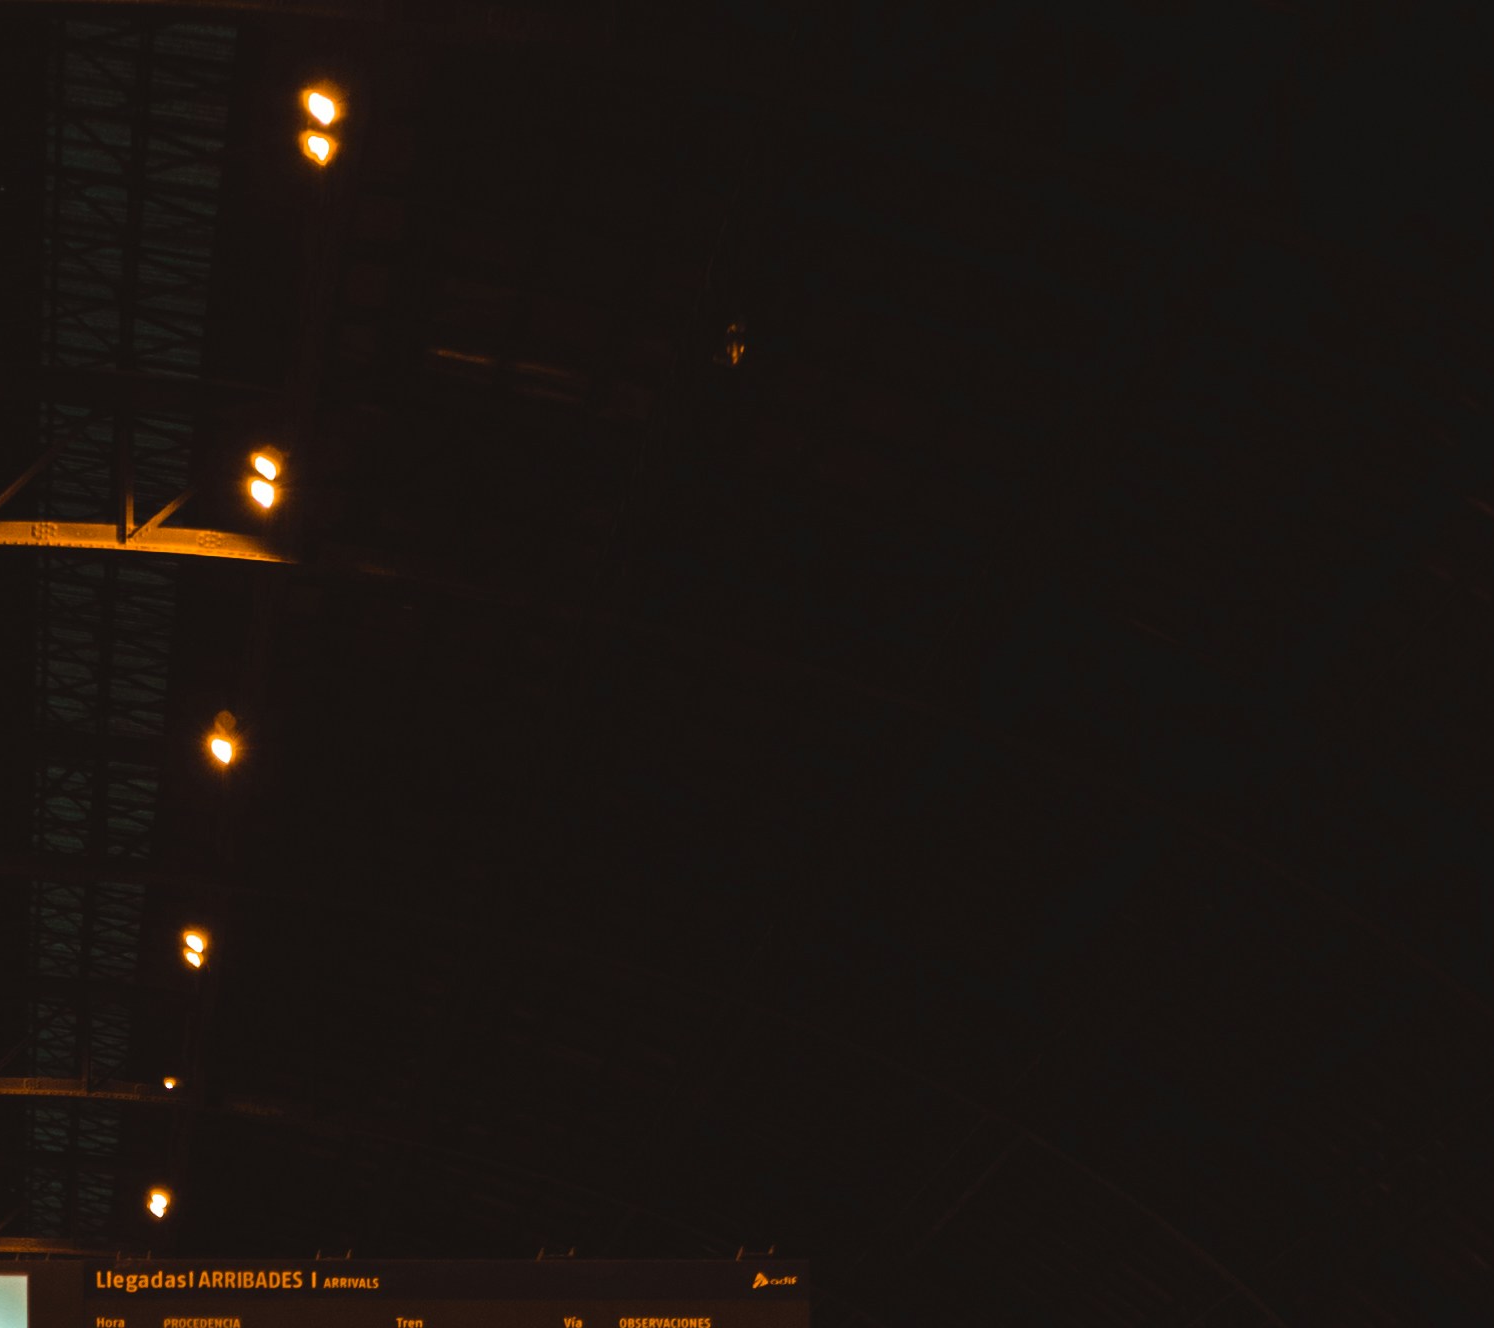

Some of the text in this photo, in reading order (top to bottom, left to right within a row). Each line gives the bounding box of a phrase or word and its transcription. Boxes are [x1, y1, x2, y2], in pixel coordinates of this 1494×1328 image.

[96, 1271, 380, 1293] Llegadas ARRIBADES ARRIVALS
[96, 1317, 126, 1328] Hora
[163, 1317, 241, 1328] PROCEDENCIA
[395, 1317, 424, 1328] Tren
[619, 1317, 711, 1328] OBSERVACIONES
